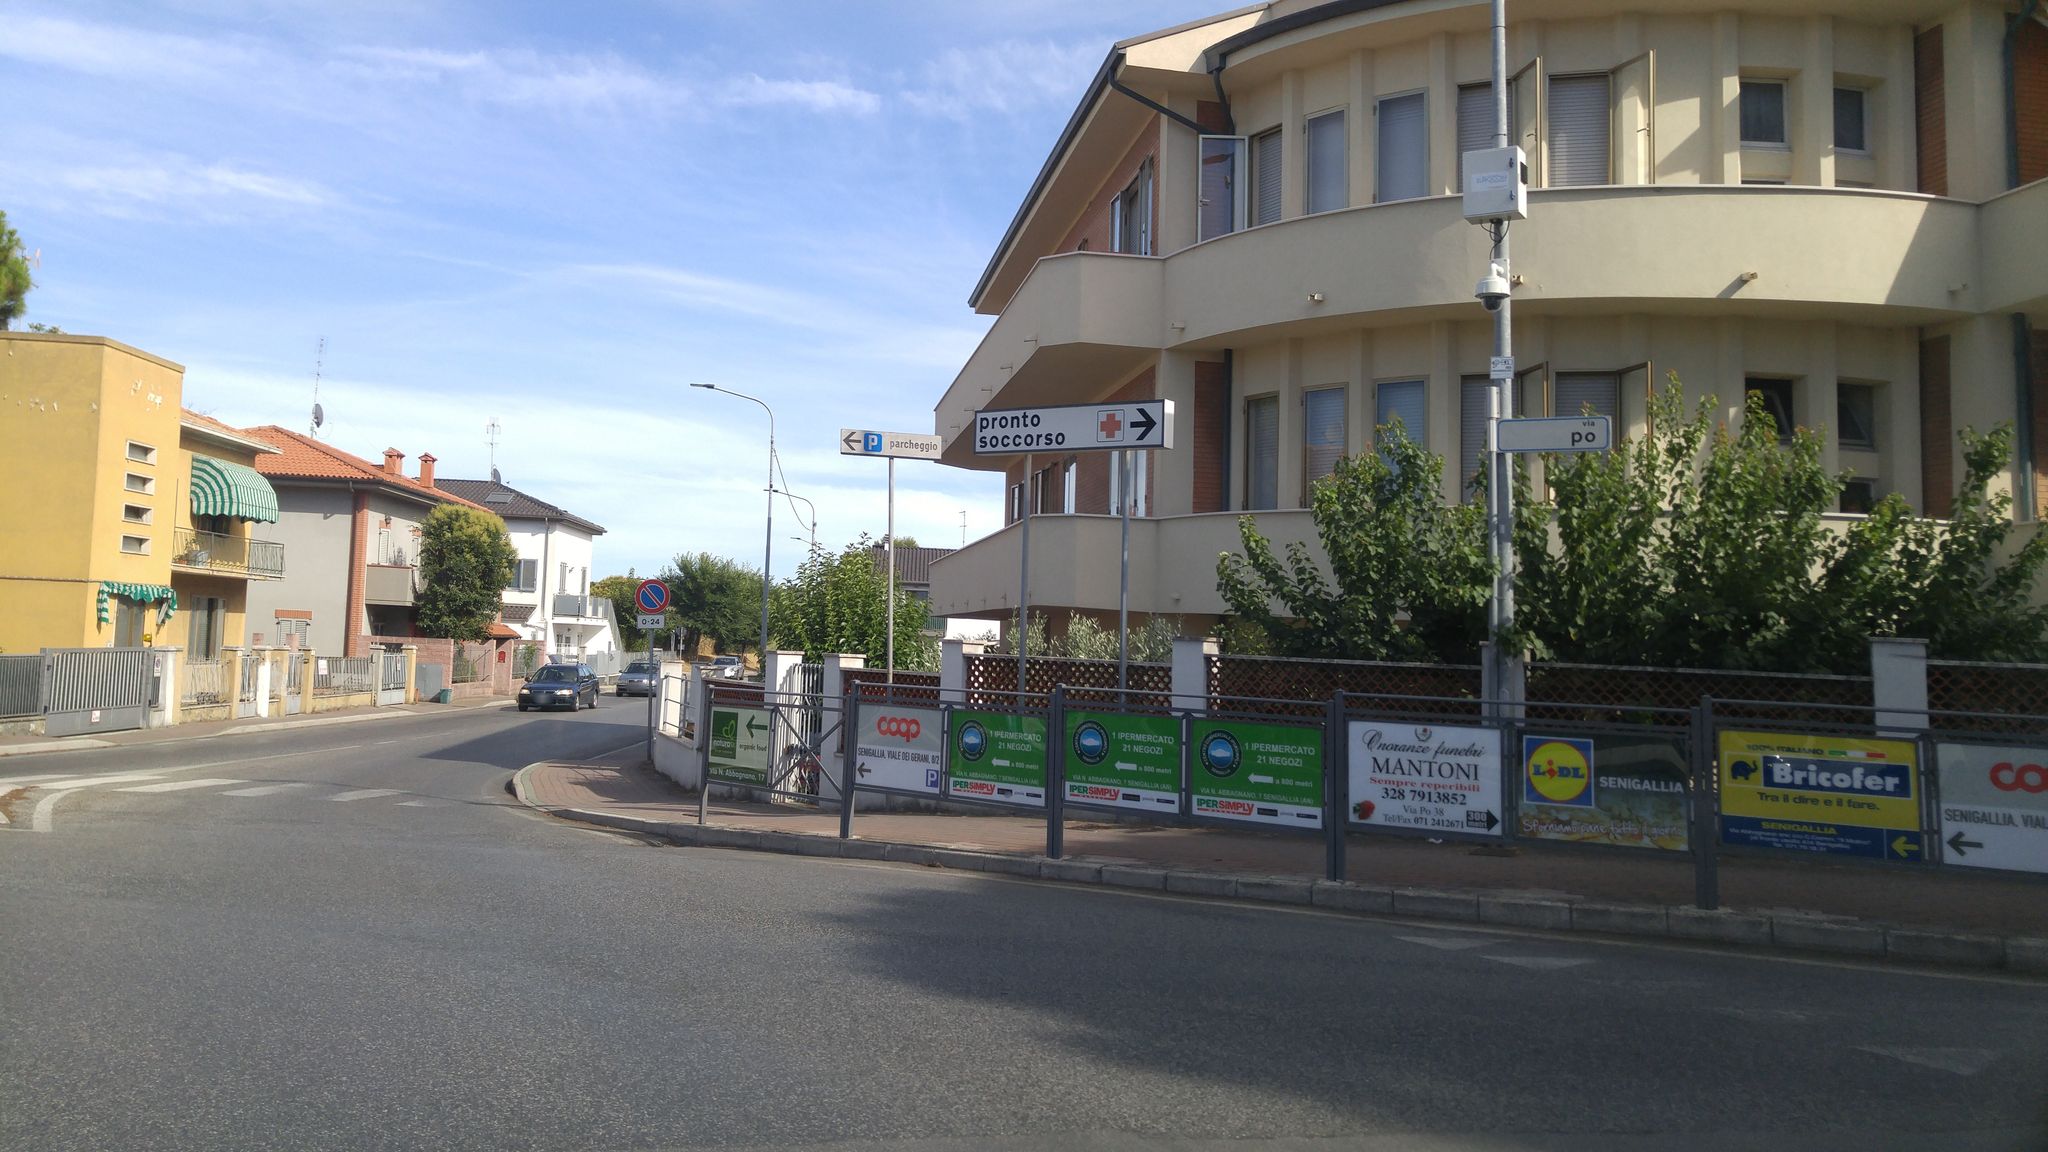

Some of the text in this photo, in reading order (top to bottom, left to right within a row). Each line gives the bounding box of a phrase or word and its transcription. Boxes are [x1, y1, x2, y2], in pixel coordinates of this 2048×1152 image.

[979, 412, 1041, 432] pronto
[889, 438, 938, 453] parcheggio
[979, 431, 1066, 449] soccorso
[1571, 430, 1596, 447] po
[876, 715, 921, 742] coop
[994, 730, 1042, 743] IPERMERCATO
[1118, 732, 1174, 745] IPERMERCATO
[1362, 729, 1485, 759] Onoranze funebri
[757, 743, 767, 752] food
[1006, 742, 1033, 752] NEGOZI
[1122, 744, 1163, 755] 21 NEGOZI
[1251, 742, 1315, 755] IPERMERCATO
[1776, 746, 1824, 755] ITALIANO
[857, 747, 886, 759] SENIGALLIA,
[887, 750, 901, 761] VIALE
[902, 752, 910, 761] DEI
[911, 753, 930, 764] GERANI,
[1257, 755, 1302, 767] 21 NEGOZI
[1371, 756, 1480, 781] MANTONI
[758, 773, 765, 781] 17
[1295, 779, 1313, 787] metri
[1370, 776, 1480, 792] Sempre reperibili
[1772, 762, 1900, 792] Bricofer
[1599, 776, 1685, 794] SENIGALLIA
[1381, 787, 1467, 806] 328 7913852
[1757, 791, 1880, 811] Tra il dire e il fare.
[1403, 805, 1445, 817] Via Po 38
[1944, 808, 2018, 827] SENIGALLIA,
[1383, 813, 1465, 829] Tel/Fax 071 2412671
[1610, 822, 1638, 834] tutto
[1760, 821, 1840, 834] SENIGALLIA
